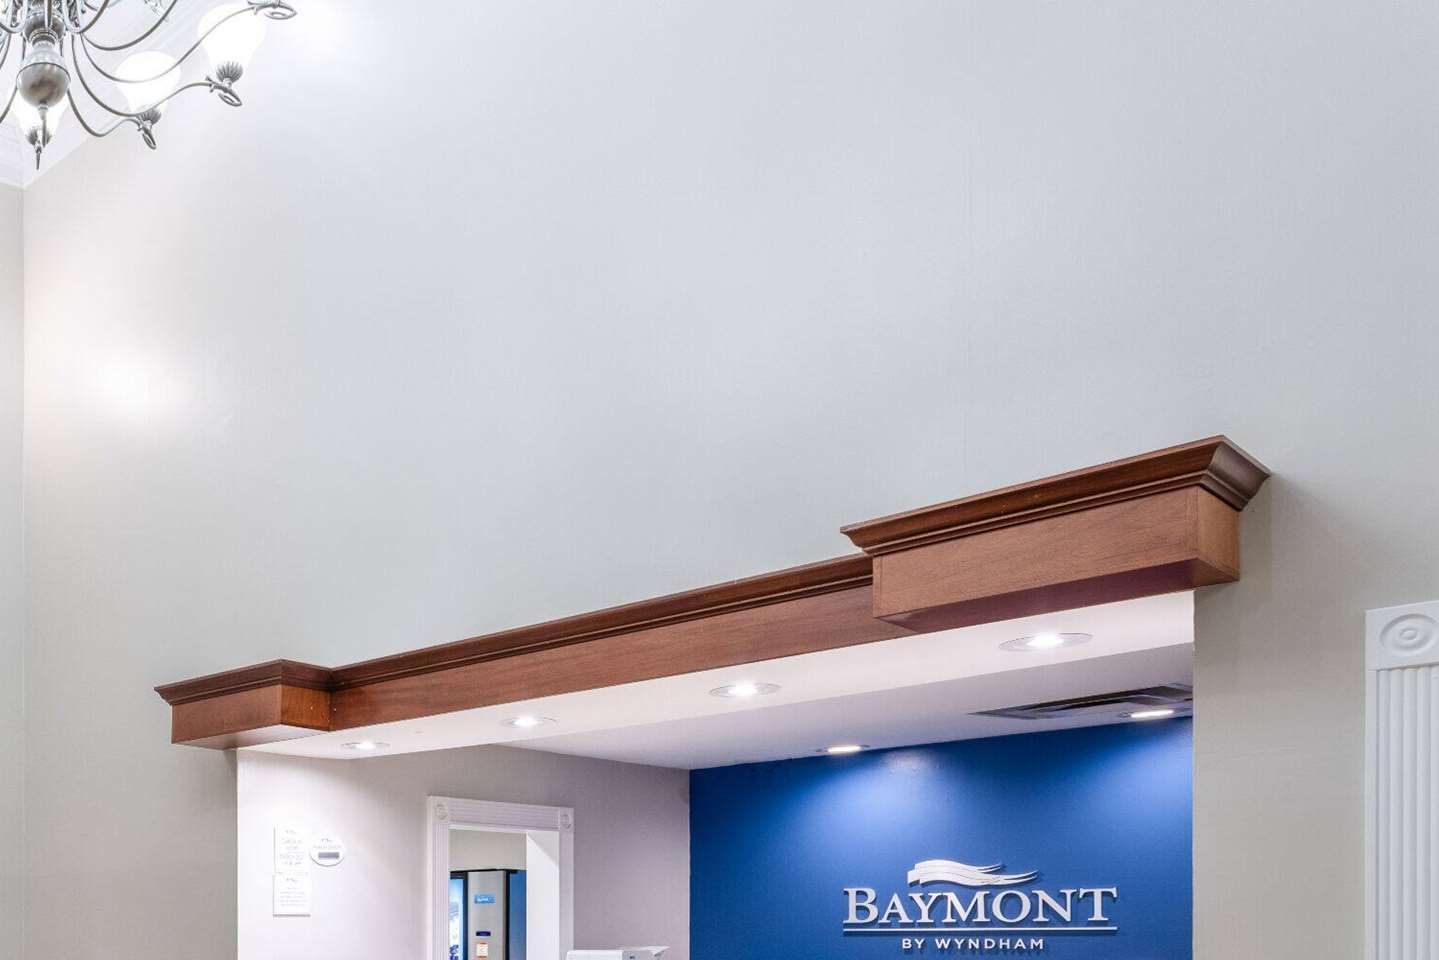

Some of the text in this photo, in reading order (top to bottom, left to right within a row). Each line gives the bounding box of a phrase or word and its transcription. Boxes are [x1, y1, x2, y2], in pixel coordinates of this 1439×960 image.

[843, 887, 1118, 924] BAYMONT
[901, 937, 1044, 950] BY WYNDHAM
